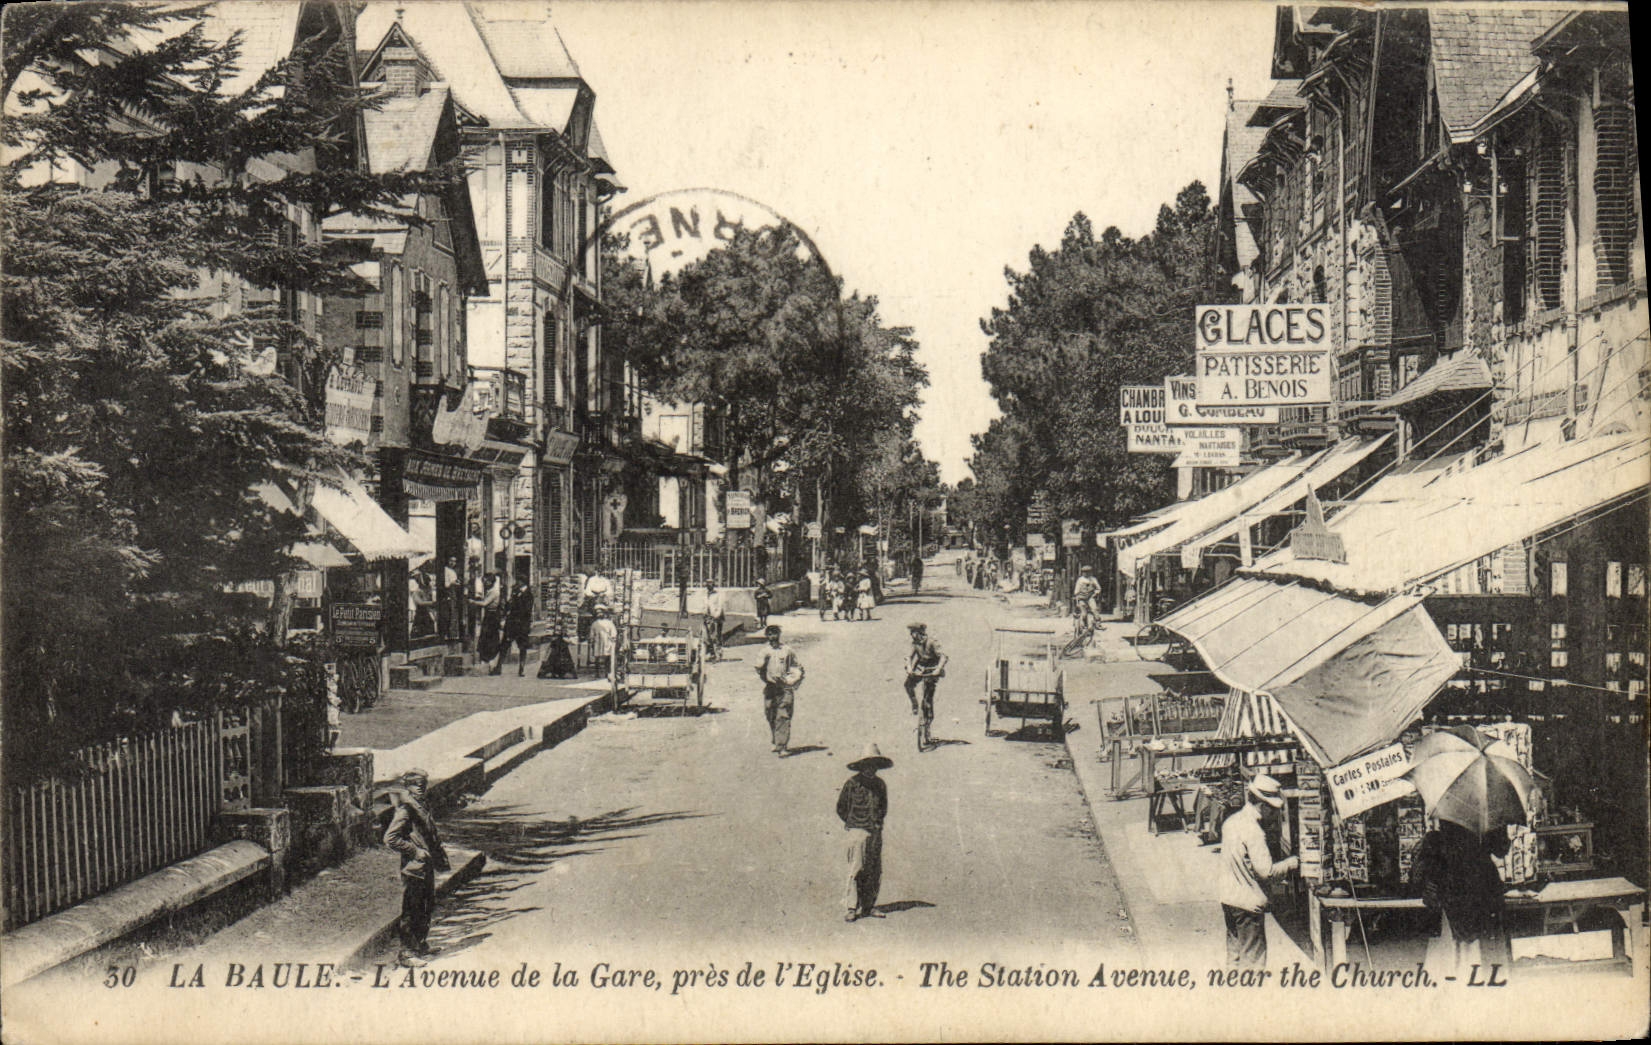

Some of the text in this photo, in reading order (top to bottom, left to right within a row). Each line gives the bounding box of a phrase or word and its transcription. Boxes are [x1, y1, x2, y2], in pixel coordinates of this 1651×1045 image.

[1200, 308, 1326, 346] GLACES
[1204, 353, 1322, 377] PATISSERIE
[1170, 380, 1196, 400] VINS
[1221, 379, 1308, 400] A. BENOIS
[1123, 411, 1132, 424] A
[1136, 434, 1185, 446] NANTA
[1333, 768, 1362, 786] Cartes
[1365, 752, 1403, 773] Postales
